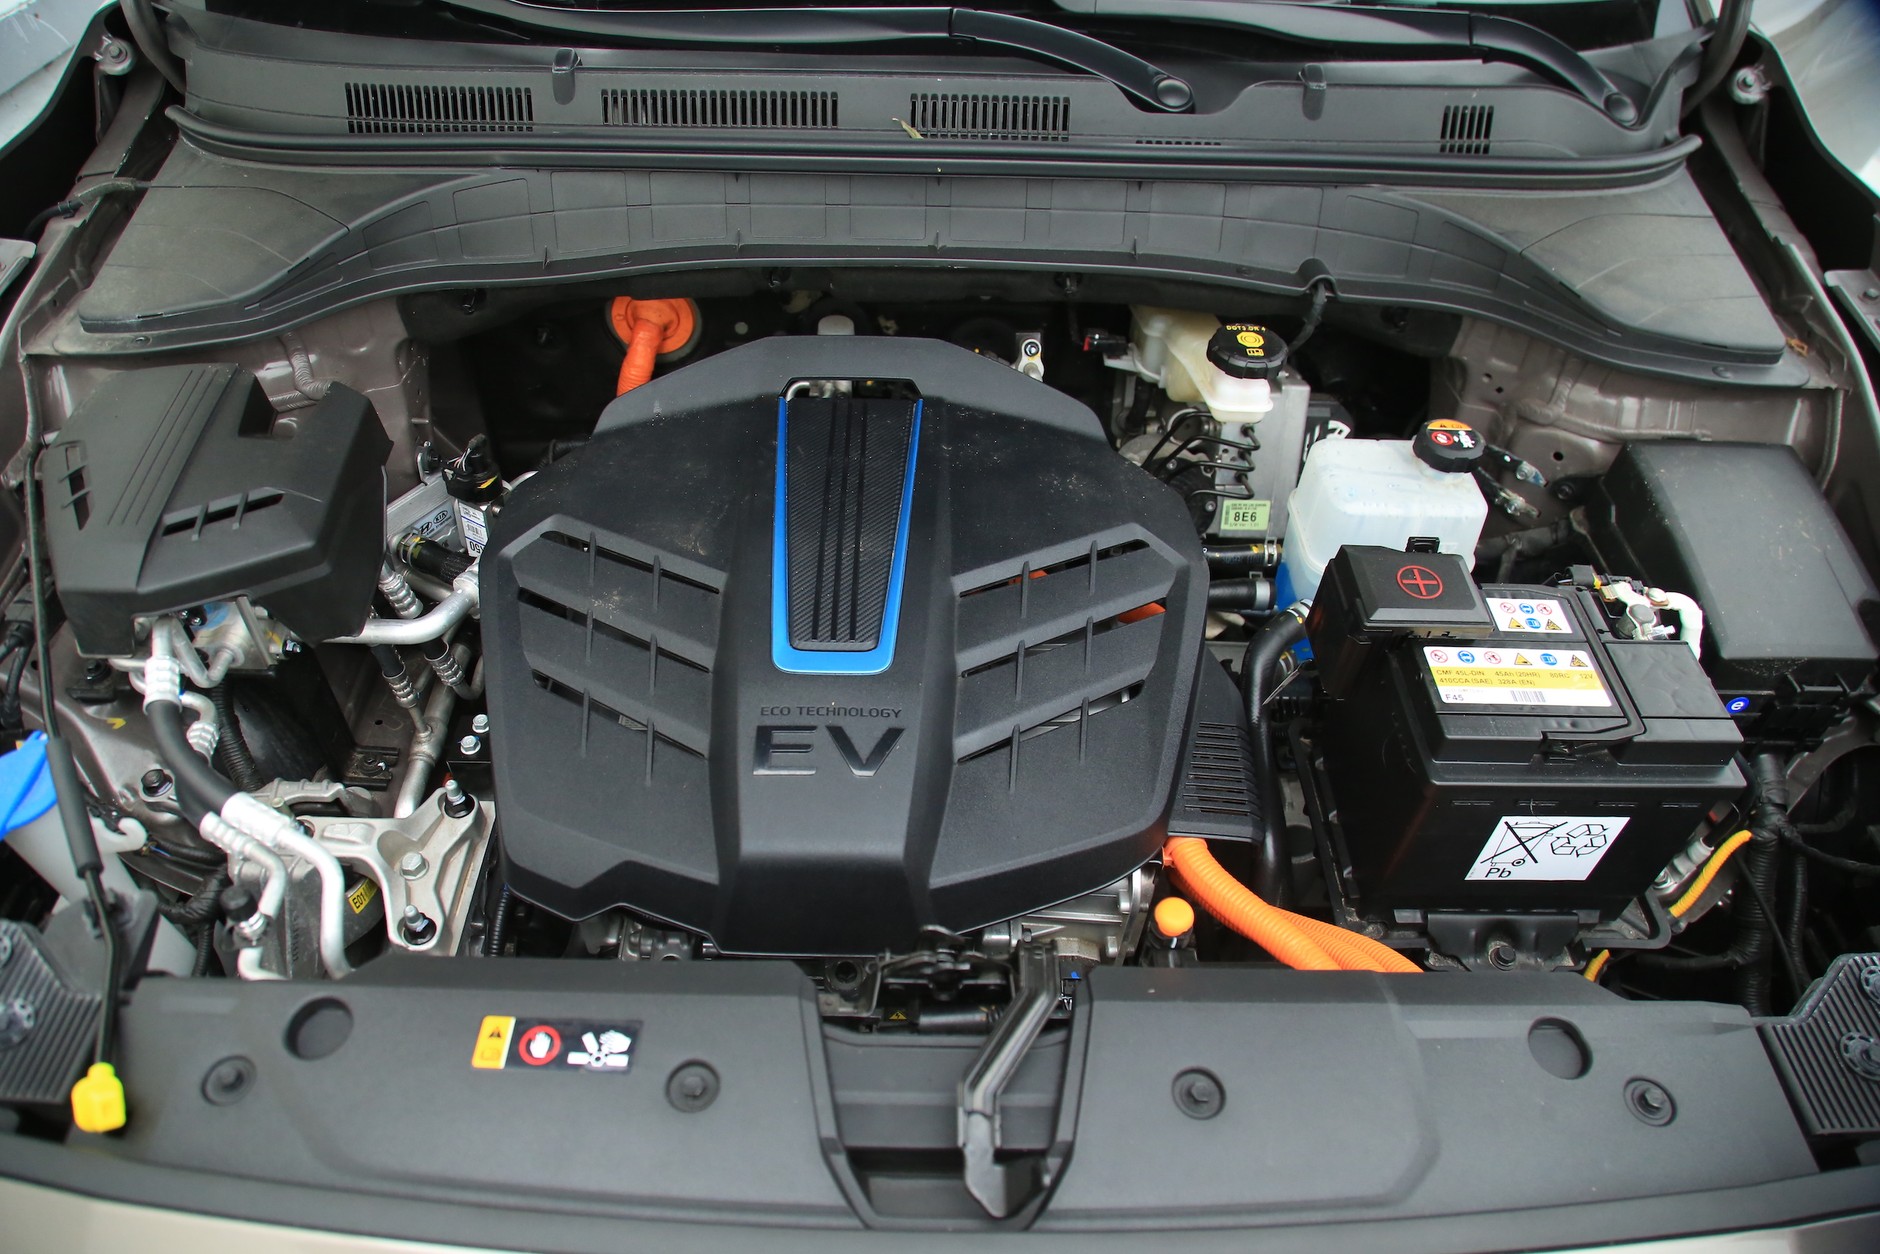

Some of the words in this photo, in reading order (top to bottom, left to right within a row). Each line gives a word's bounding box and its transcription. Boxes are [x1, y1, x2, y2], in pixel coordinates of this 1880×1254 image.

[1233, 511, 1257, 522] 8E6
[469, 541, 485, 553] 50
[760, 706, 791, 716] ECO
[796, 706, 902, 718] TECHNOLOGY
[752, 725, 906, 778] EV
[1485, 867, 1512, 878] Pb
